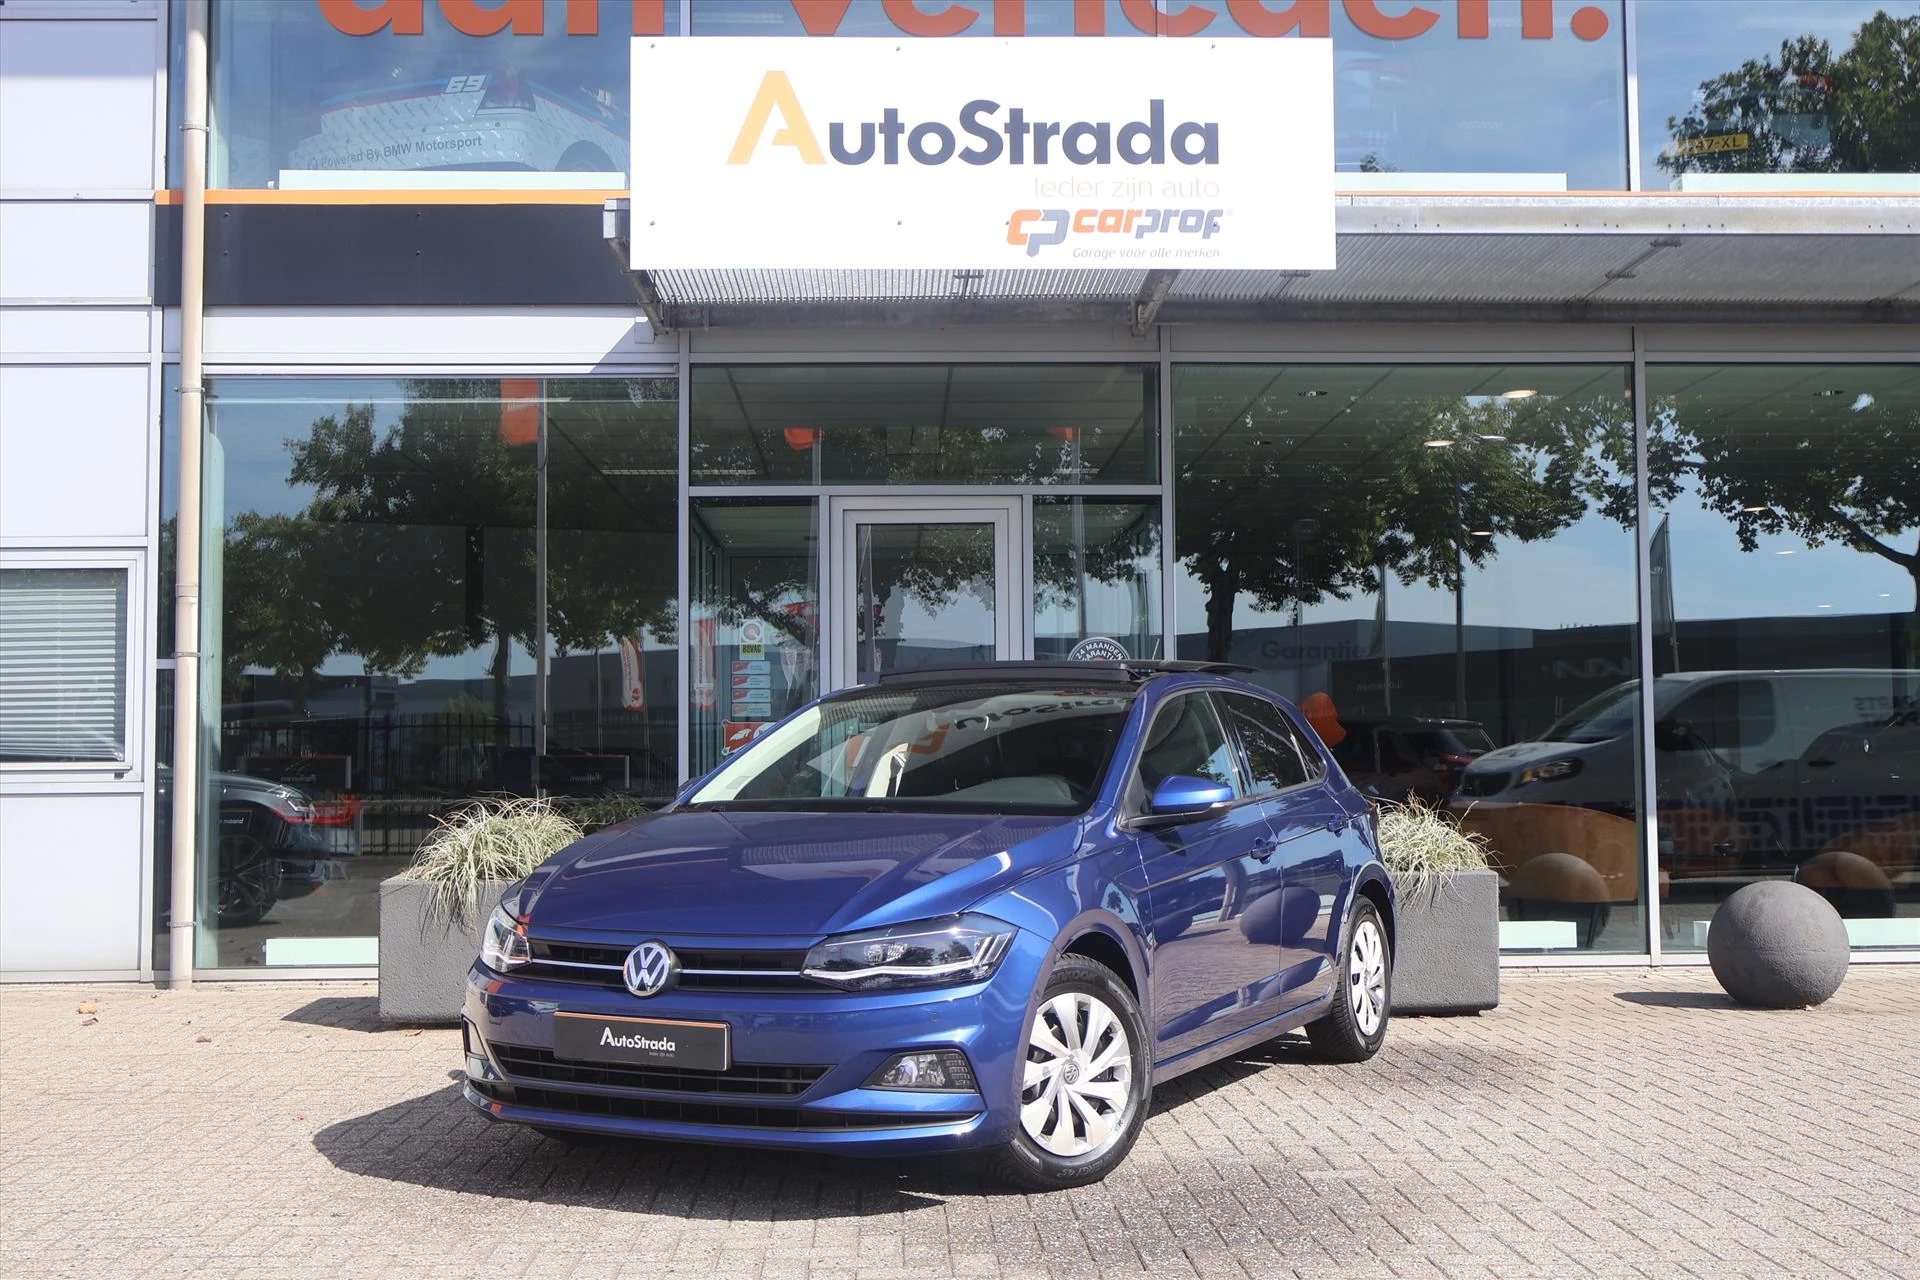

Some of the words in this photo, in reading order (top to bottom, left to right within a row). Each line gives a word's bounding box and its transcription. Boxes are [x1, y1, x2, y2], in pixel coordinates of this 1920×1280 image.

[446, 75, 486, 92] 69
[726, 70, 1219, 166] AutoStrada
[320, 149, 363, 168] Powered
[366, 148, 381, 160] By
[383, 142, 411, 157] BMW
[415, 135, 482, 152] Motorsport
[1112, 176, 1152, 202] zijn
[1162, 177, 1220, 198] auto
[1073, 209, 1223, 239] carprof
[1073, 248, 1116, 259] Garage
[1119, 249, 1146, 258] voor
[1150, 248, 1172, 258] alle
[1175, 248, 1220, 258] merken
[1085, 642, 1123, 660] MAANDEN
[600, 1026, 676, 1052] AutoStrada
